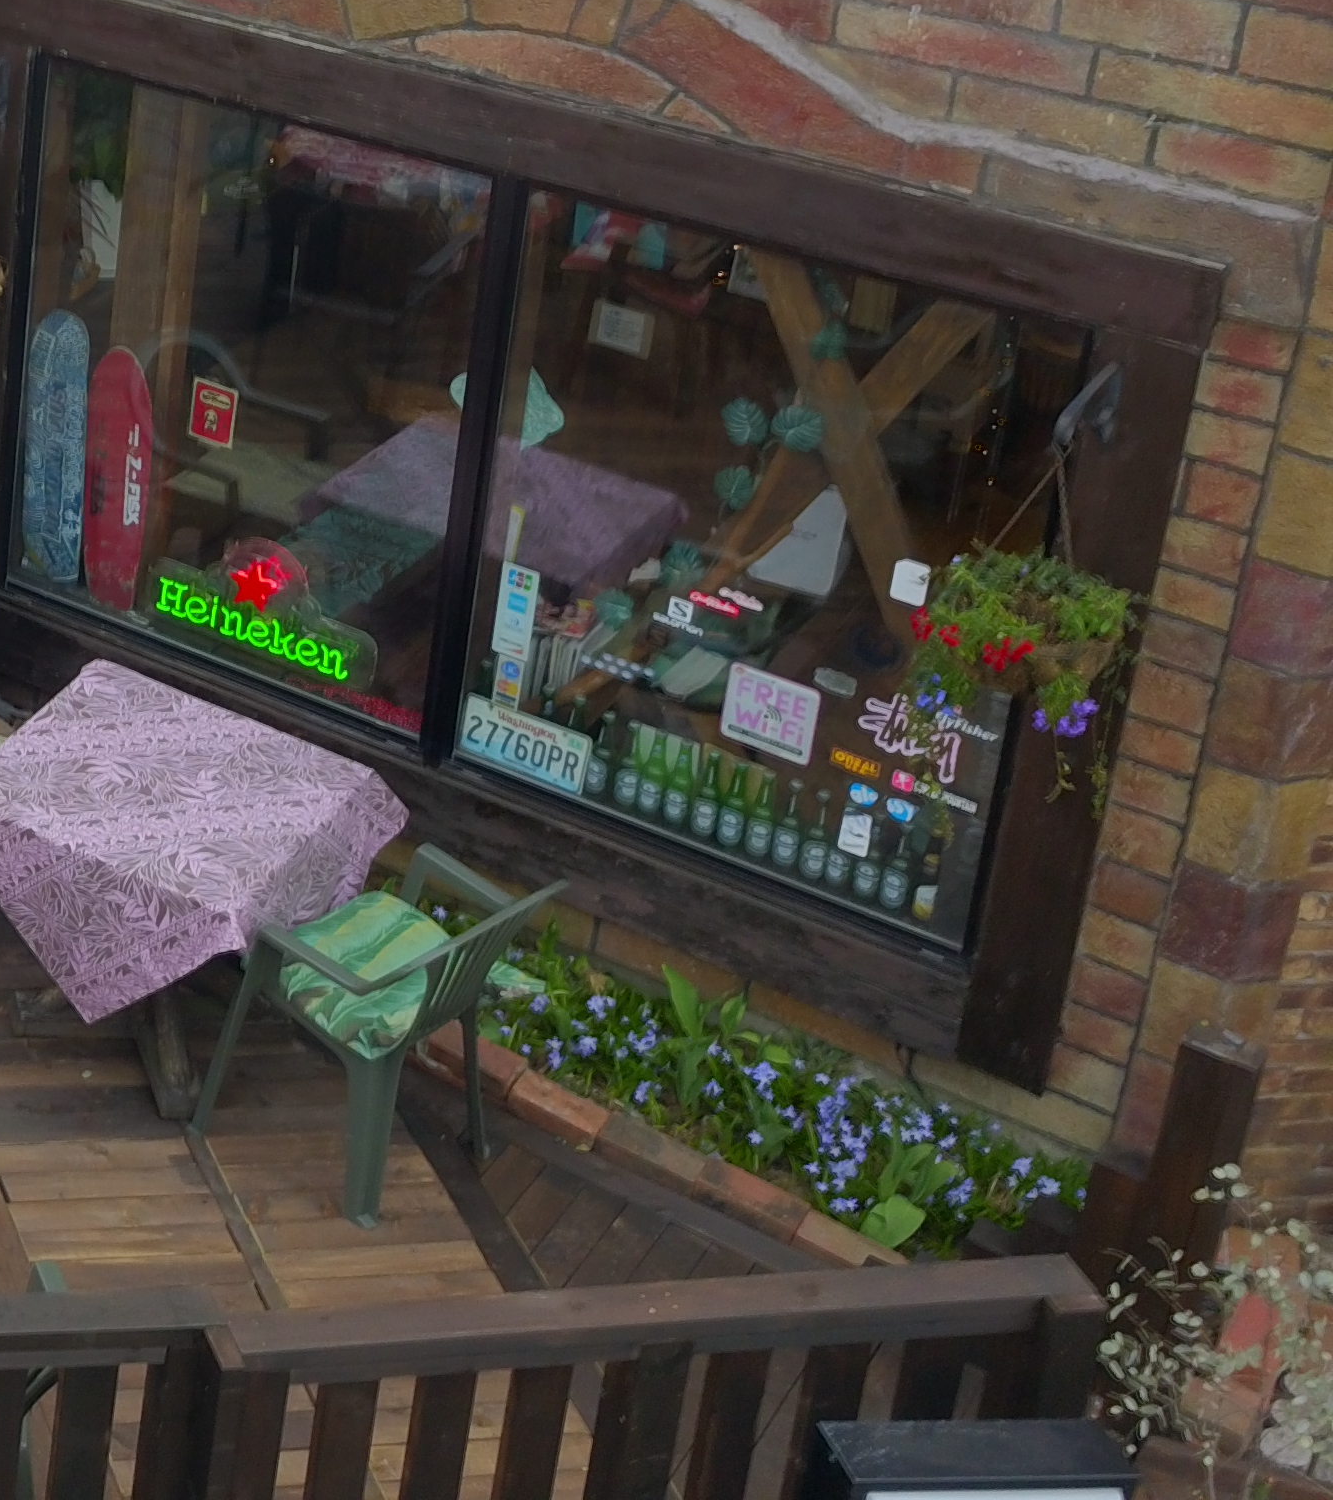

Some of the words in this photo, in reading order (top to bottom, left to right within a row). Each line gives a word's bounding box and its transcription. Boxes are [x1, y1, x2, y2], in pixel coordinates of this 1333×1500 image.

[155, 576, 348, 680] Heineken
[736, 676, 807, 721] FREE
[497, 709, 557, 743] Washington
[735, 701, 804, 747] Wi-Fi
[466, 714, 579, 782] 27760PR
